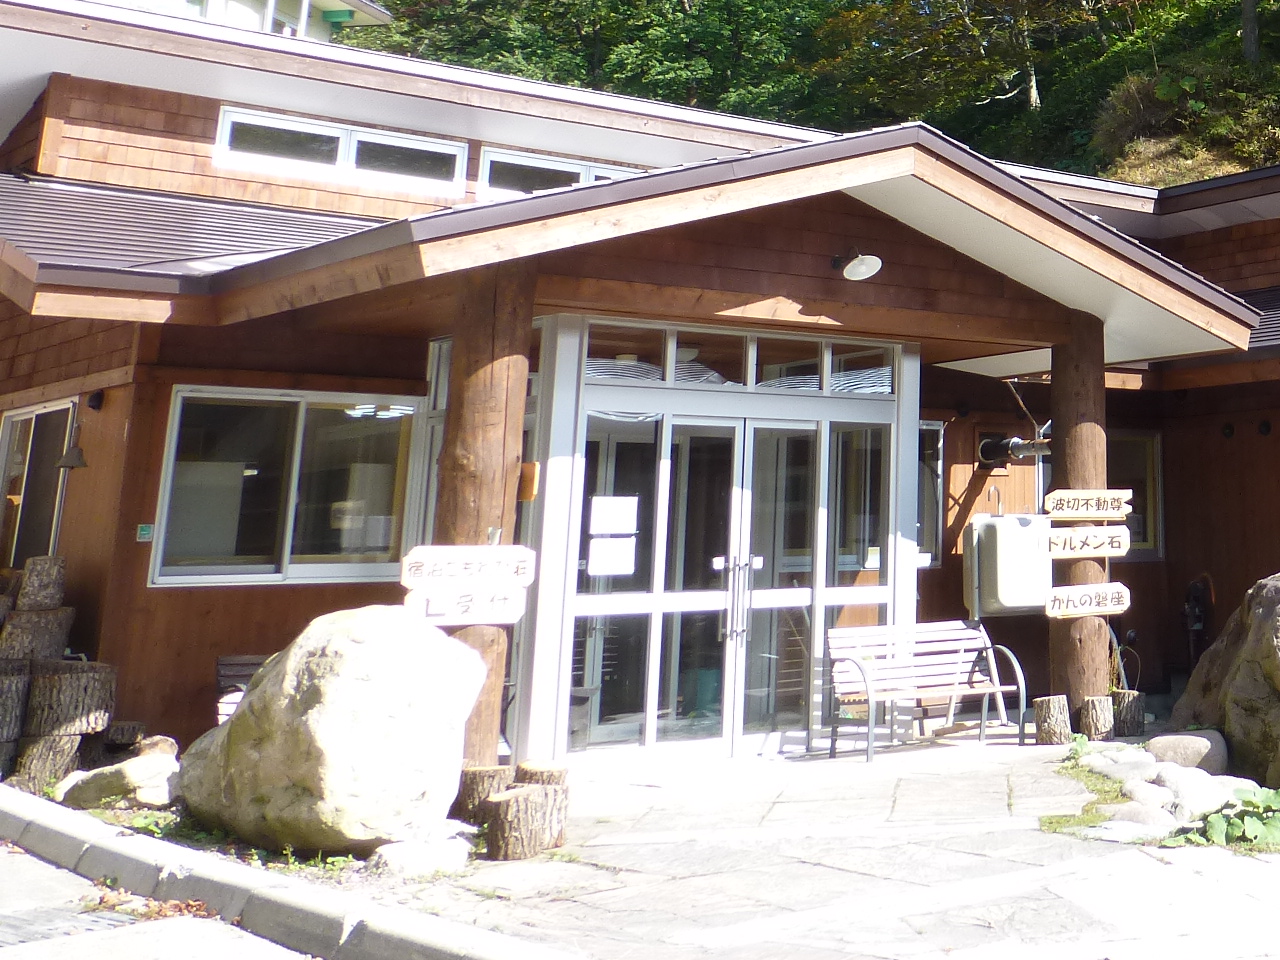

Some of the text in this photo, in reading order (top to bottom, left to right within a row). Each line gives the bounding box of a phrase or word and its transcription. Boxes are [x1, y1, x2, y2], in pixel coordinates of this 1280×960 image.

[1051, 496, 1124, 512] 波切不動尊
[1048, 534, 1122, 553] ドルメン石
[1050, 591, 1125, 611] かんの磐座
